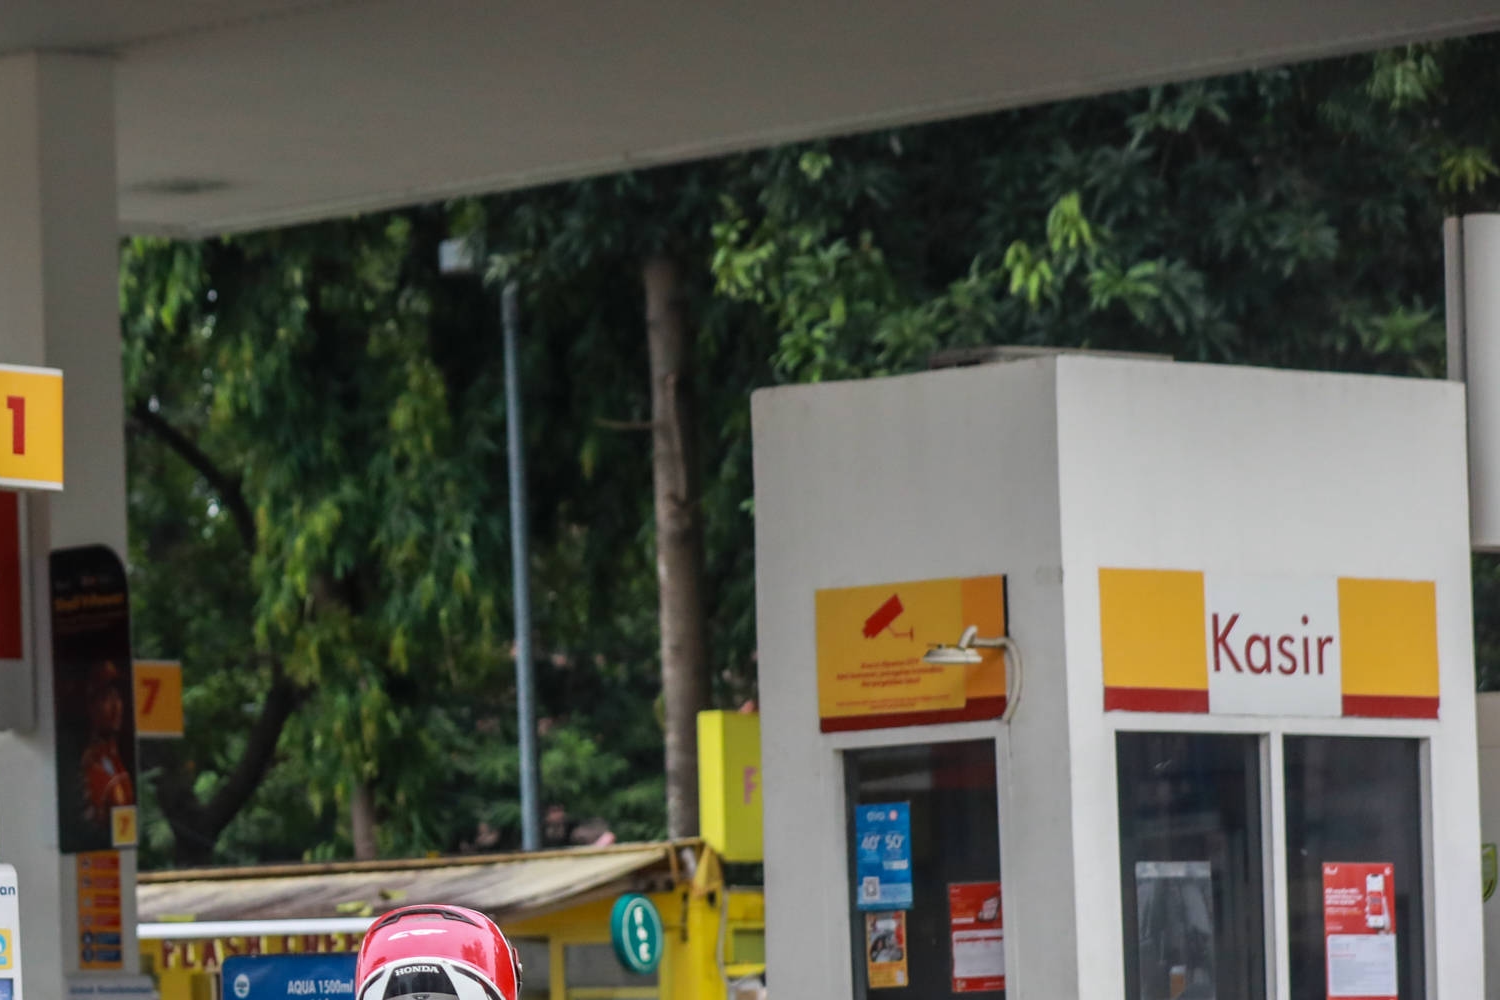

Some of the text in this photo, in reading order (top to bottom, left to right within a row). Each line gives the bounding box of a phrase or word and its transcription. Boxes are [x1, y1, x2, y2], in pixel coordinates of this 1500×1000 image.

[7, 395, 25, 456] 1
[1211, 611, 1334, 677] Kasir
[141, 678, 161, 715] 7
[287, 979, 353, 995] AQUA 1500ml
[394, 965, 440, 977] HONDA
